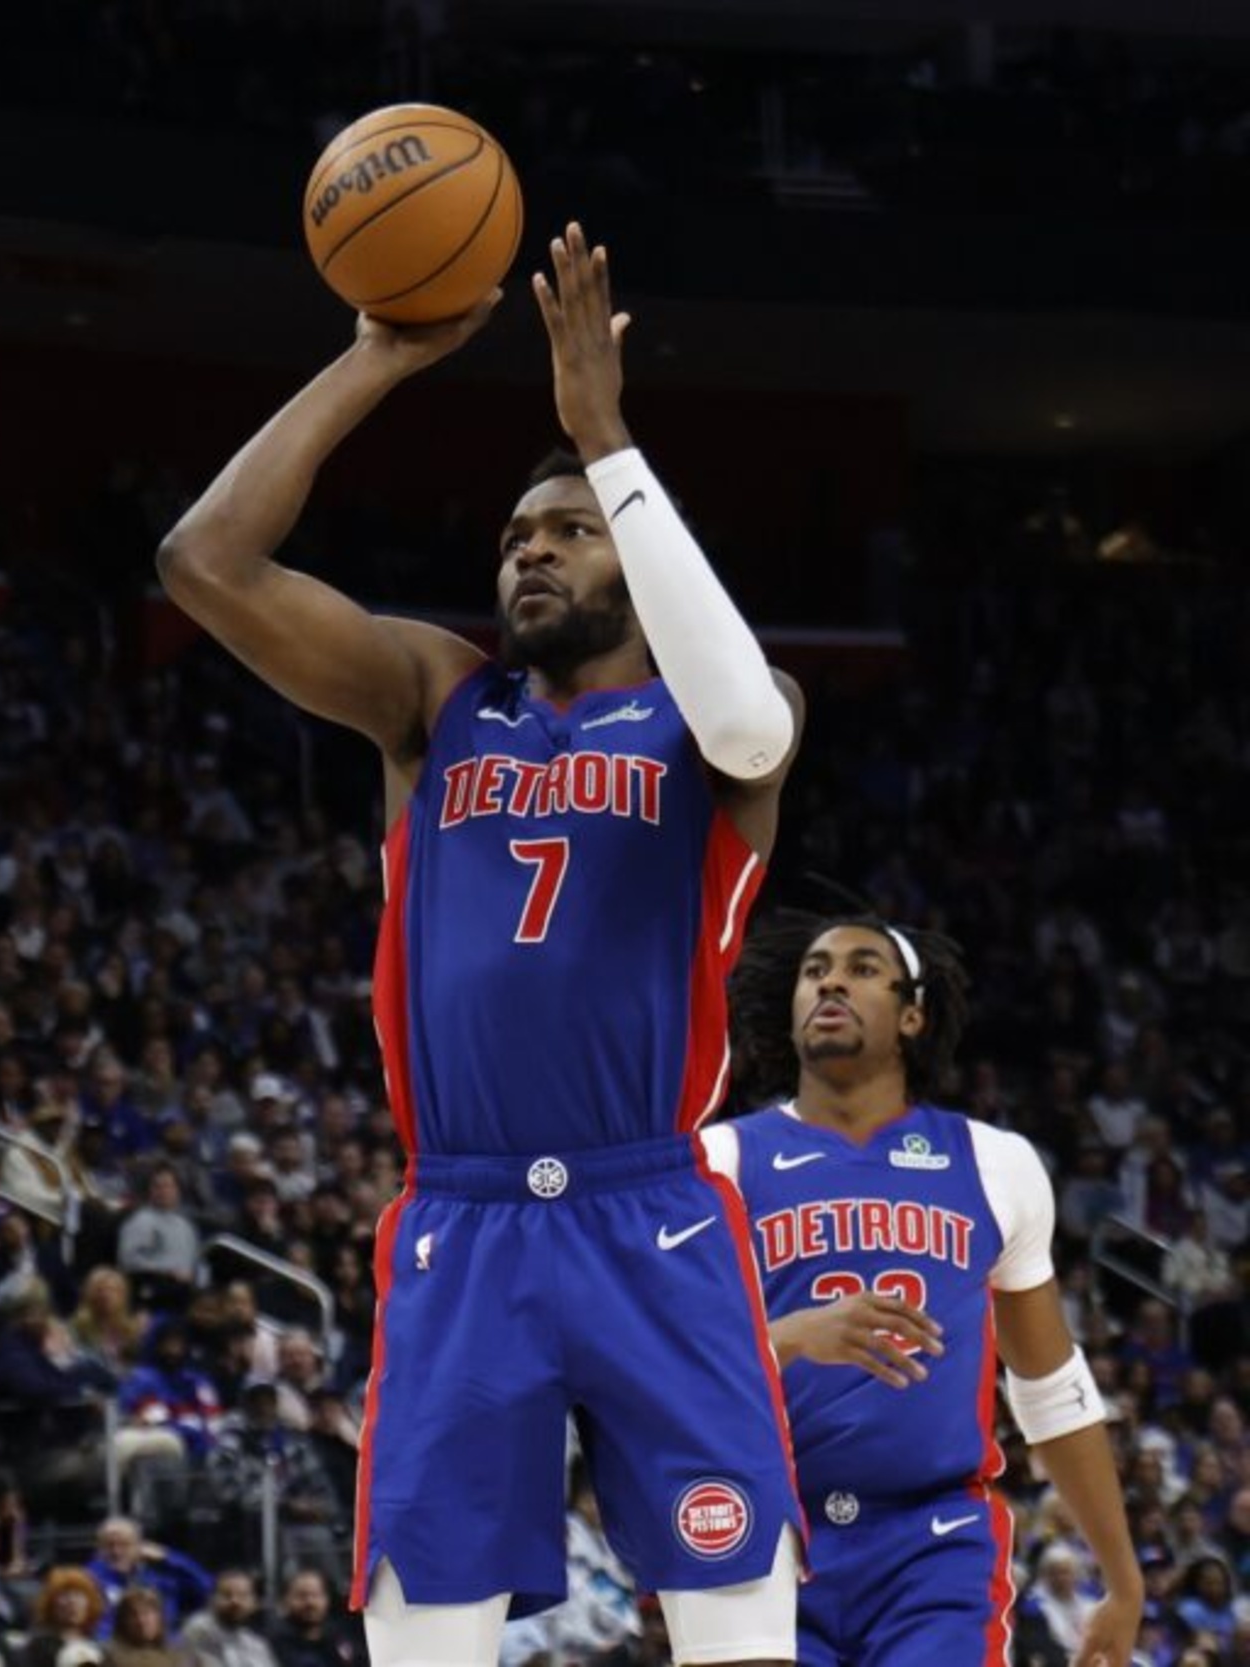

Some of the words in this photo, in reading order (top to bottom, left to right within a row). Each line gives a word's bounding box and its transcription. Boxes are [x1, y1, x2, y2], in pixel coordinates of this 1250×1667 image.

[311, 135, 432, 227] Wilson
[439, 750, 667, 830] DETROIT
[509, 837, 570, 943] 7
[756, 1198, 974, 1272] DETROIT
